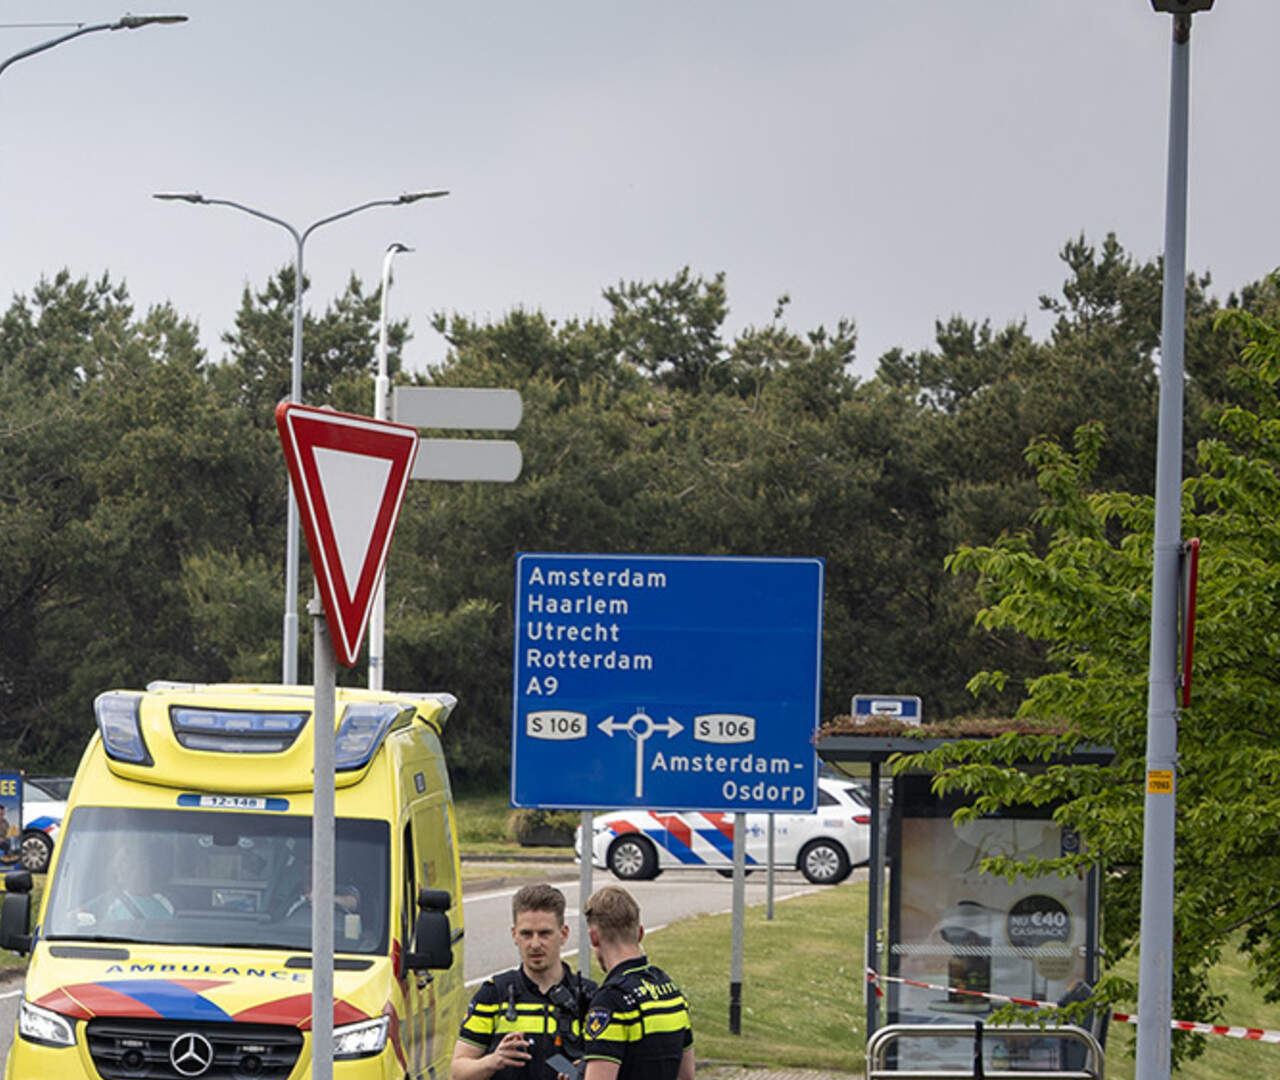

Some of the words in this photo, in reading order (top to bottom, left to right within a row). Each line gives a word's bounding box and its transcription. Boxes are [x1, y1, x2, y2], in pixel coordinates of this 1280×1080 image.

[528, 567, 667, 588] Amsterdam
[527, 594, 629, 614] Haarlem
[527, 621, 620, 642] Utrecht
[526, 648, 654, 671] Rotterdam
[526, 676, 559, 696] A9
[531, 718, 544, 733] S
[550, 718, 582, 734] 106
[699, 720, 711, 736] S
[718, 721, 750, 737] 106
[651, 752, 804, 774] Amsterdam-
[721, 780, 806, 805] Osdorp
[1031, 911, 1067, 927] €40
[106, 963, 307, 983] AMBULANCE
